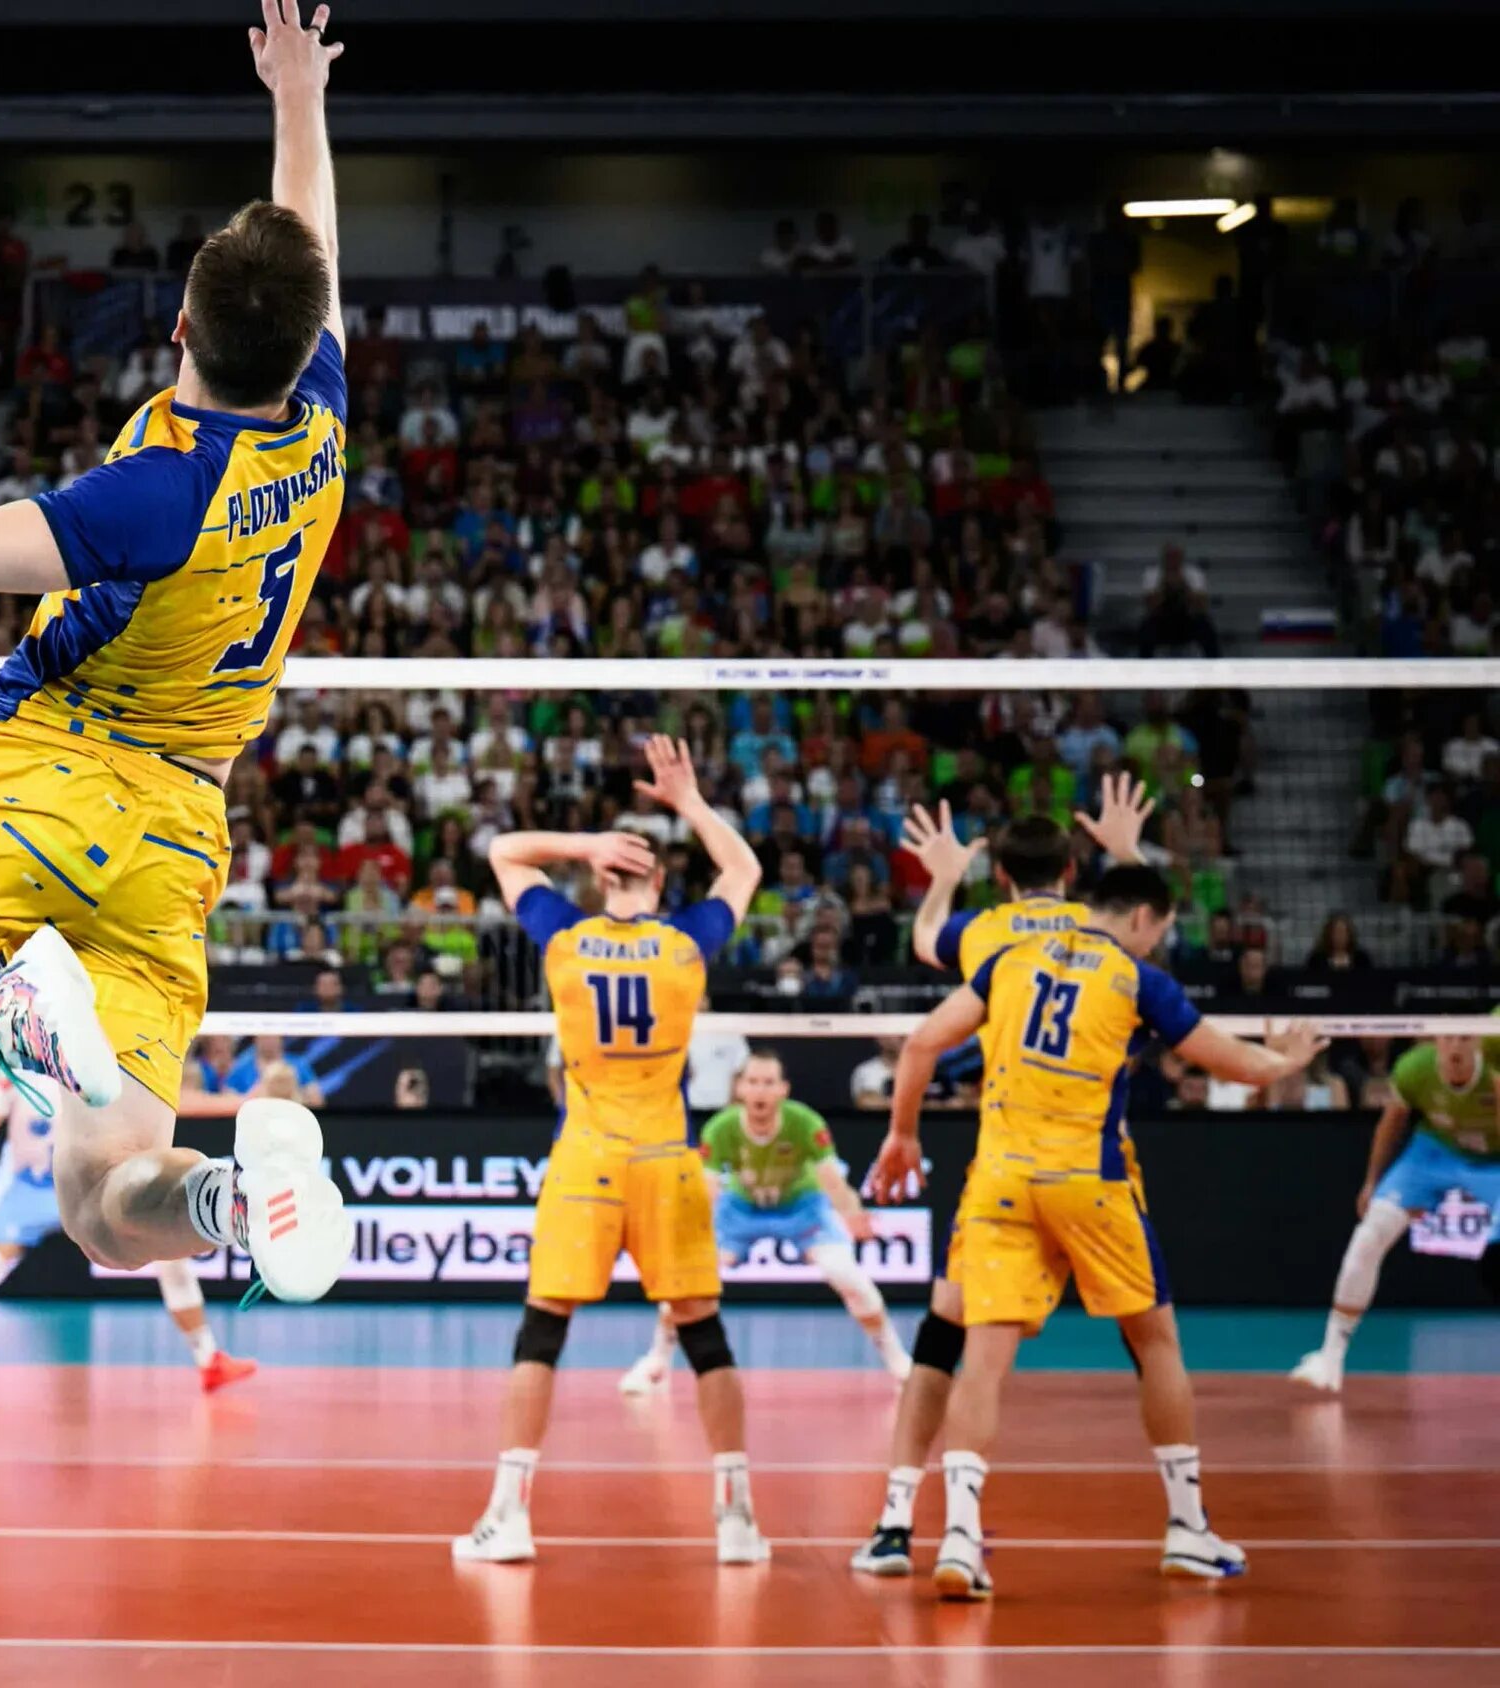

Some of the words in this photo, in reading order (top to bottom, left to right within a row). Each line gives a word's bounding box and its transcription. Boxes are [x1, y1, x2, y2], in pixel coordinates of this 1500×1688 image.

[66, 182, 133, 226] 23
[211, 526, 304, 675] 9
[585, 972, 657, 1047] 14
[1022, 969, 1080, 1061] 13
